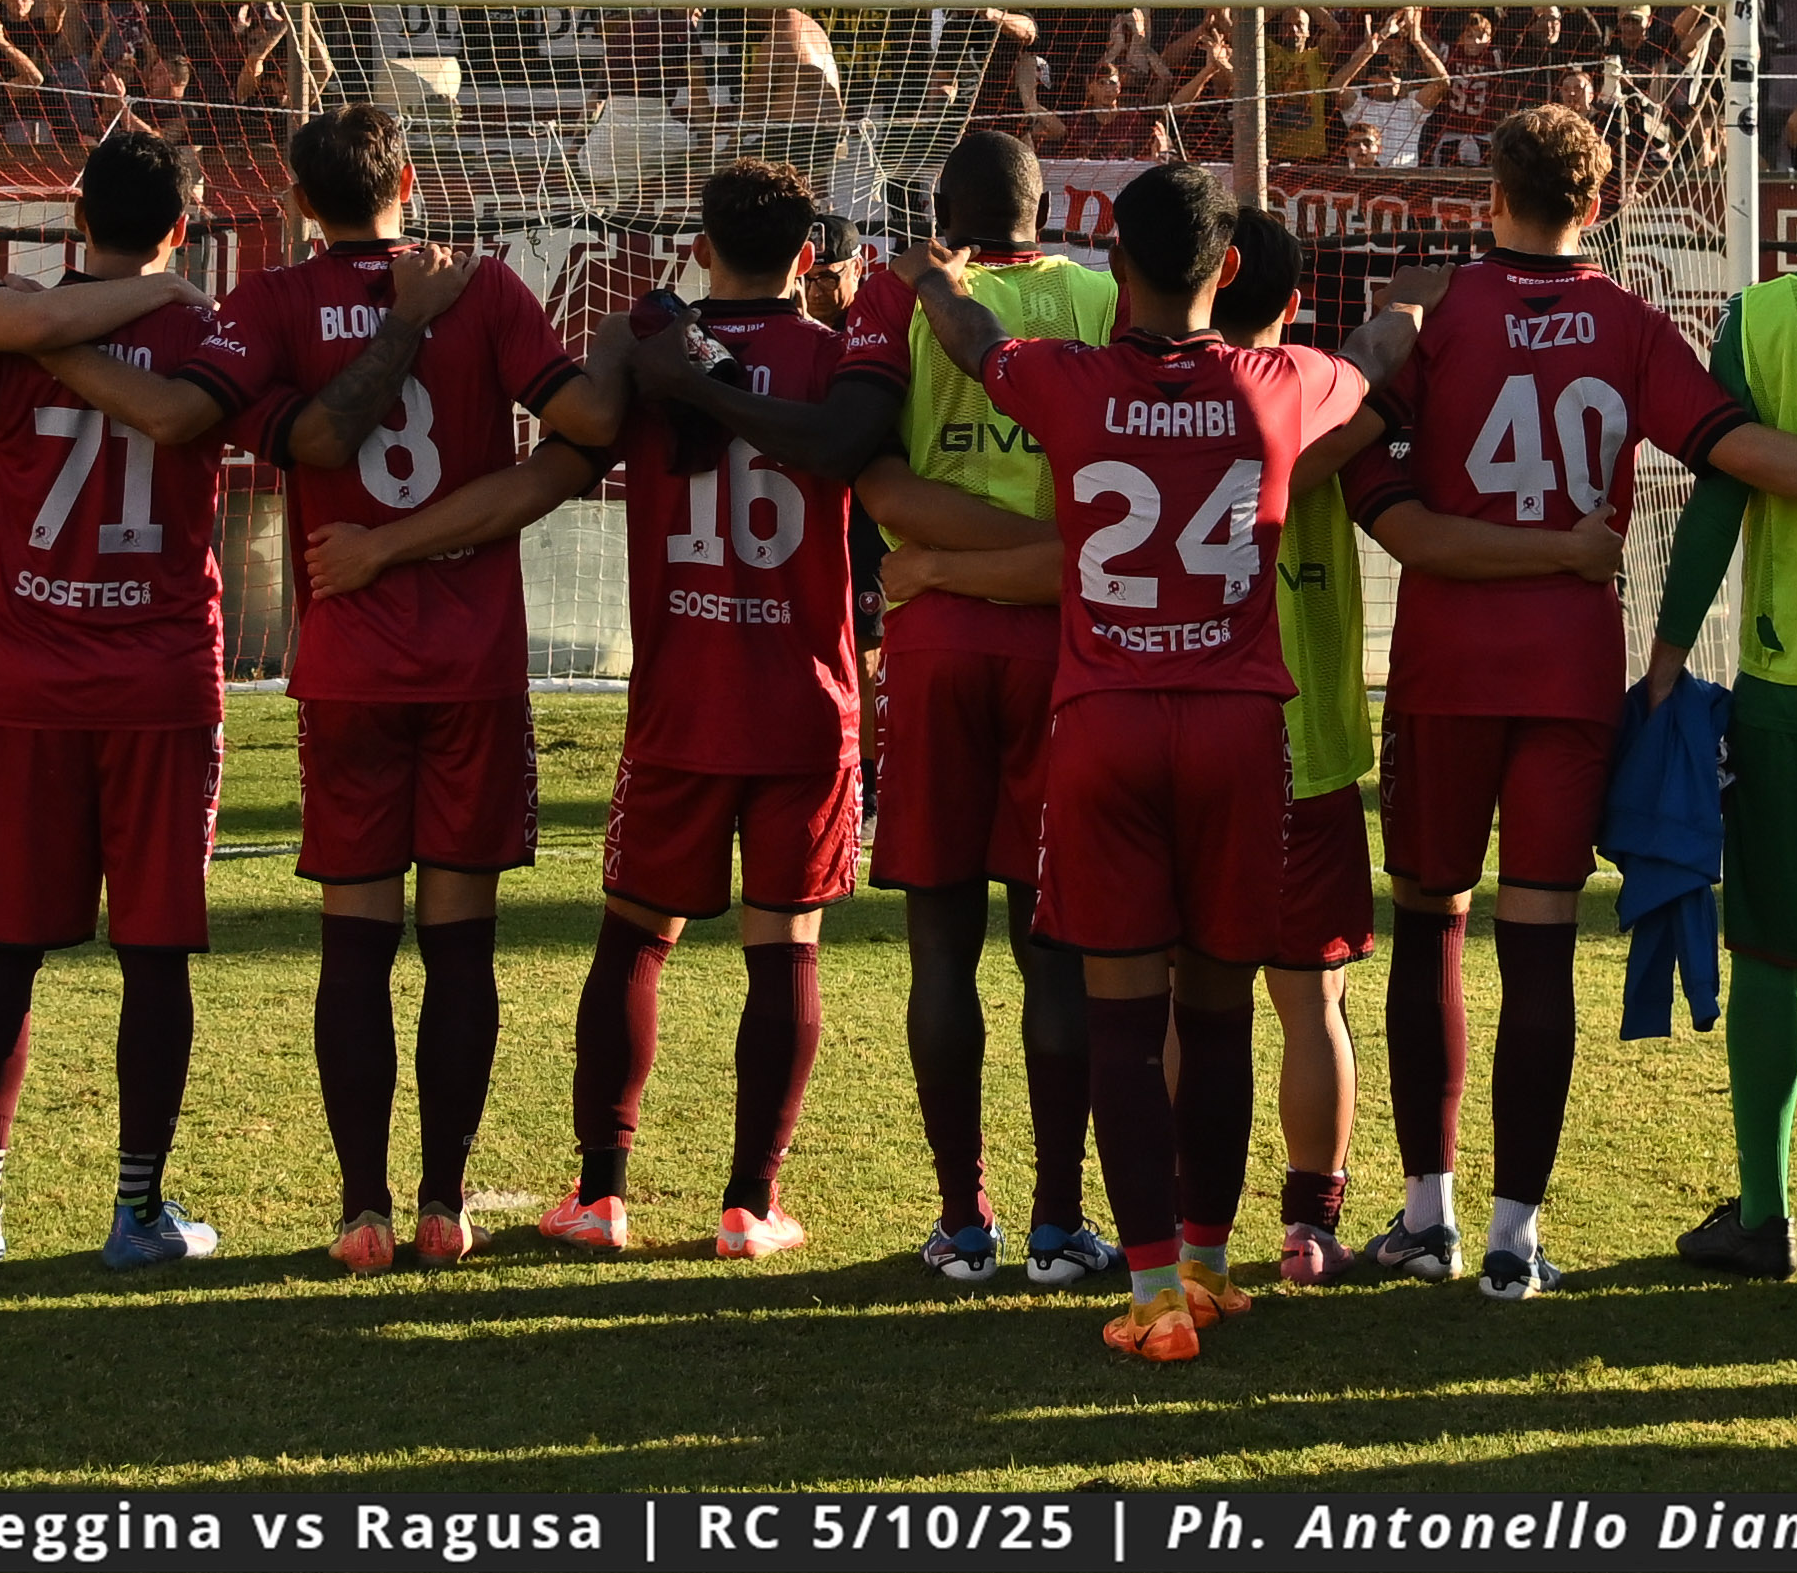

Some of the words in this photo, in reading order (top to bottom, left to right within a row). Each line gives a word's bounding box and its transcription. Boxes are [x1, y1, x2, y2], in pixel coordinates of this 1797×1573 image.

[28, 406, 163, 554] 71
[358, 373, 442, 509] 8
[1105, 396, 1237, 438] LAARIBI
[1464, 373, 1628, 521] 40
[667, 436, 806, 569] 16
[1072, 458, 1263, 609] 24
[14, 570, 142, 609] SOSETEG
[669, 589, 780, 625] SOSETEG
